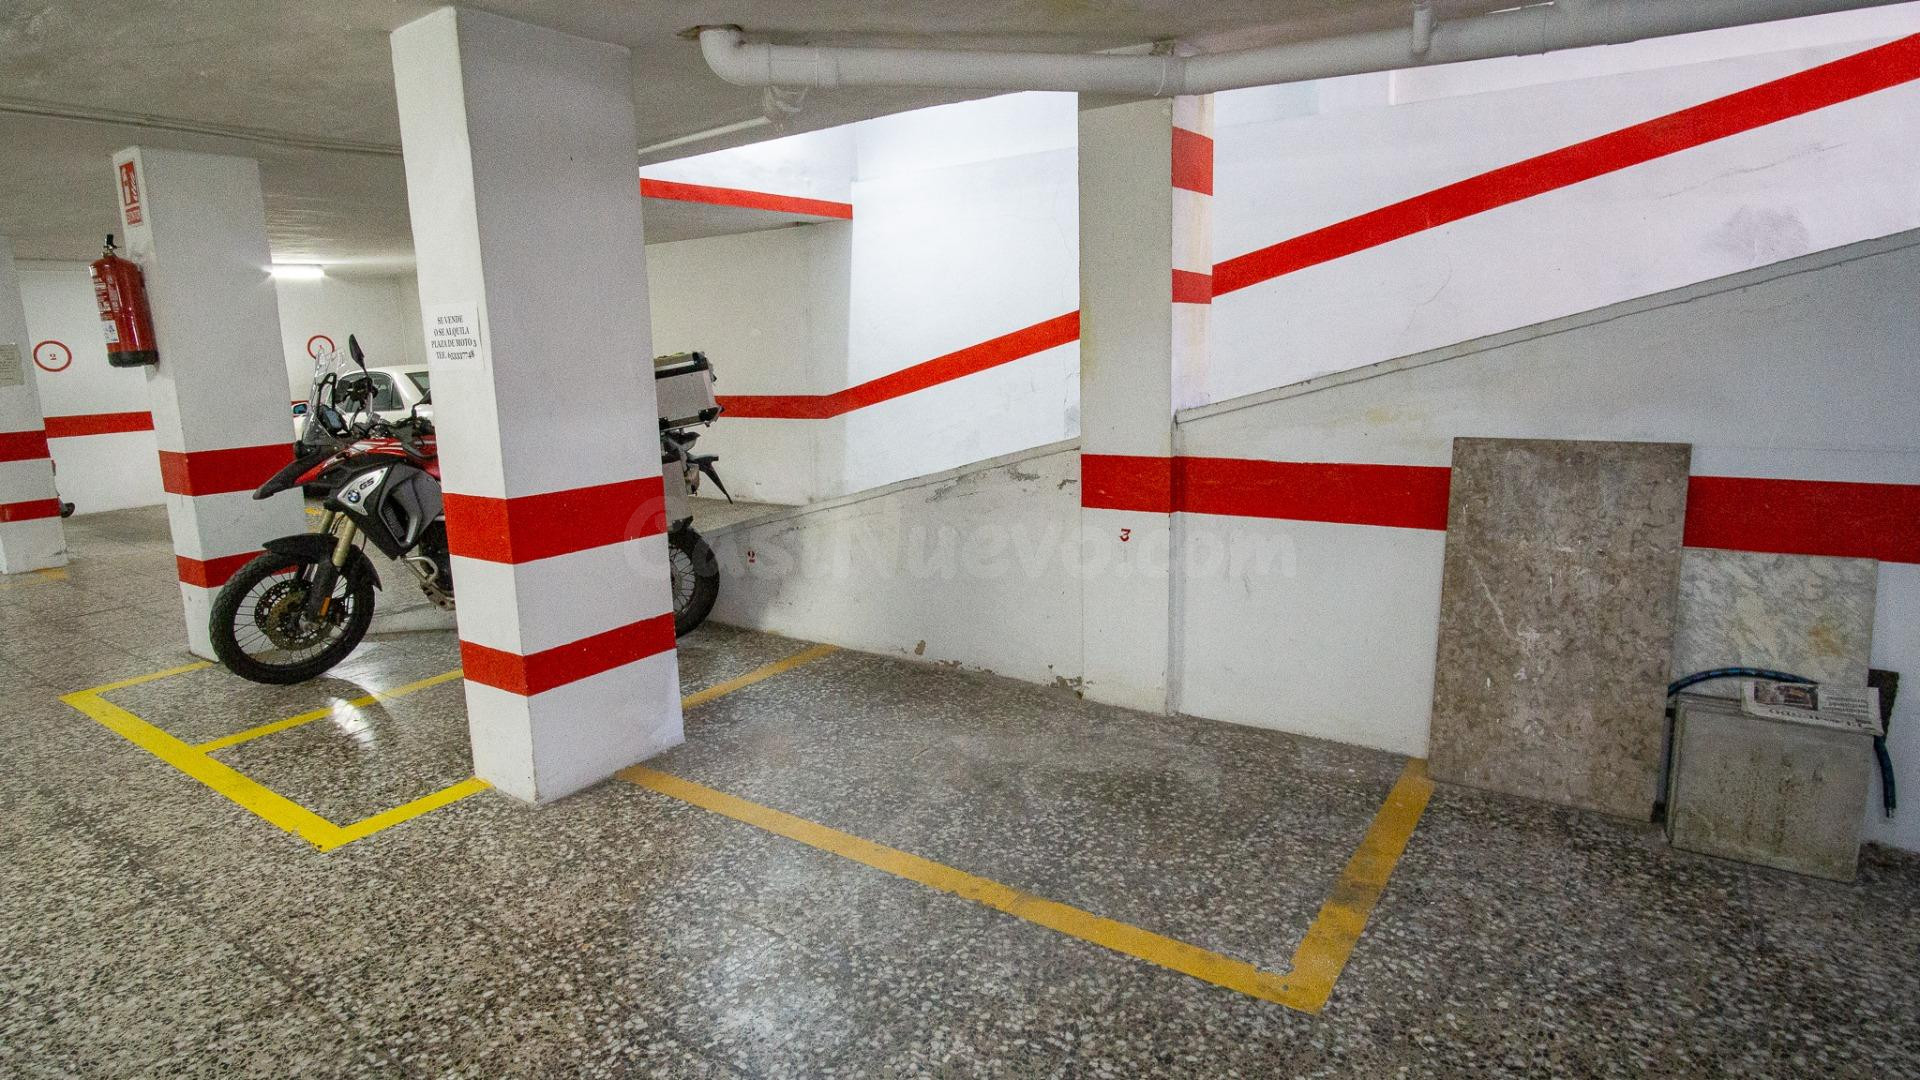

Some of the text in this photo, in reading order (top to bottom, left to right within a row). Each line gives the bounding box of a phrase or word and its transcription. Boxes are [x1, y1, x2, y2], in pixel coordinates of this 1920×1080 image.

[444, 315, 463, 324] VENDE
[445, 326, 470, 337] ALQUILA
[431, 340, 448, 348] PLAZA
[448, 339, 455, 347] DE
[455, 338, 472, 347] MOTO
[49, 353, 57, 361] 2
[359, 477, 374, 490] GS
[1119, 528, 1131, 542] 3
